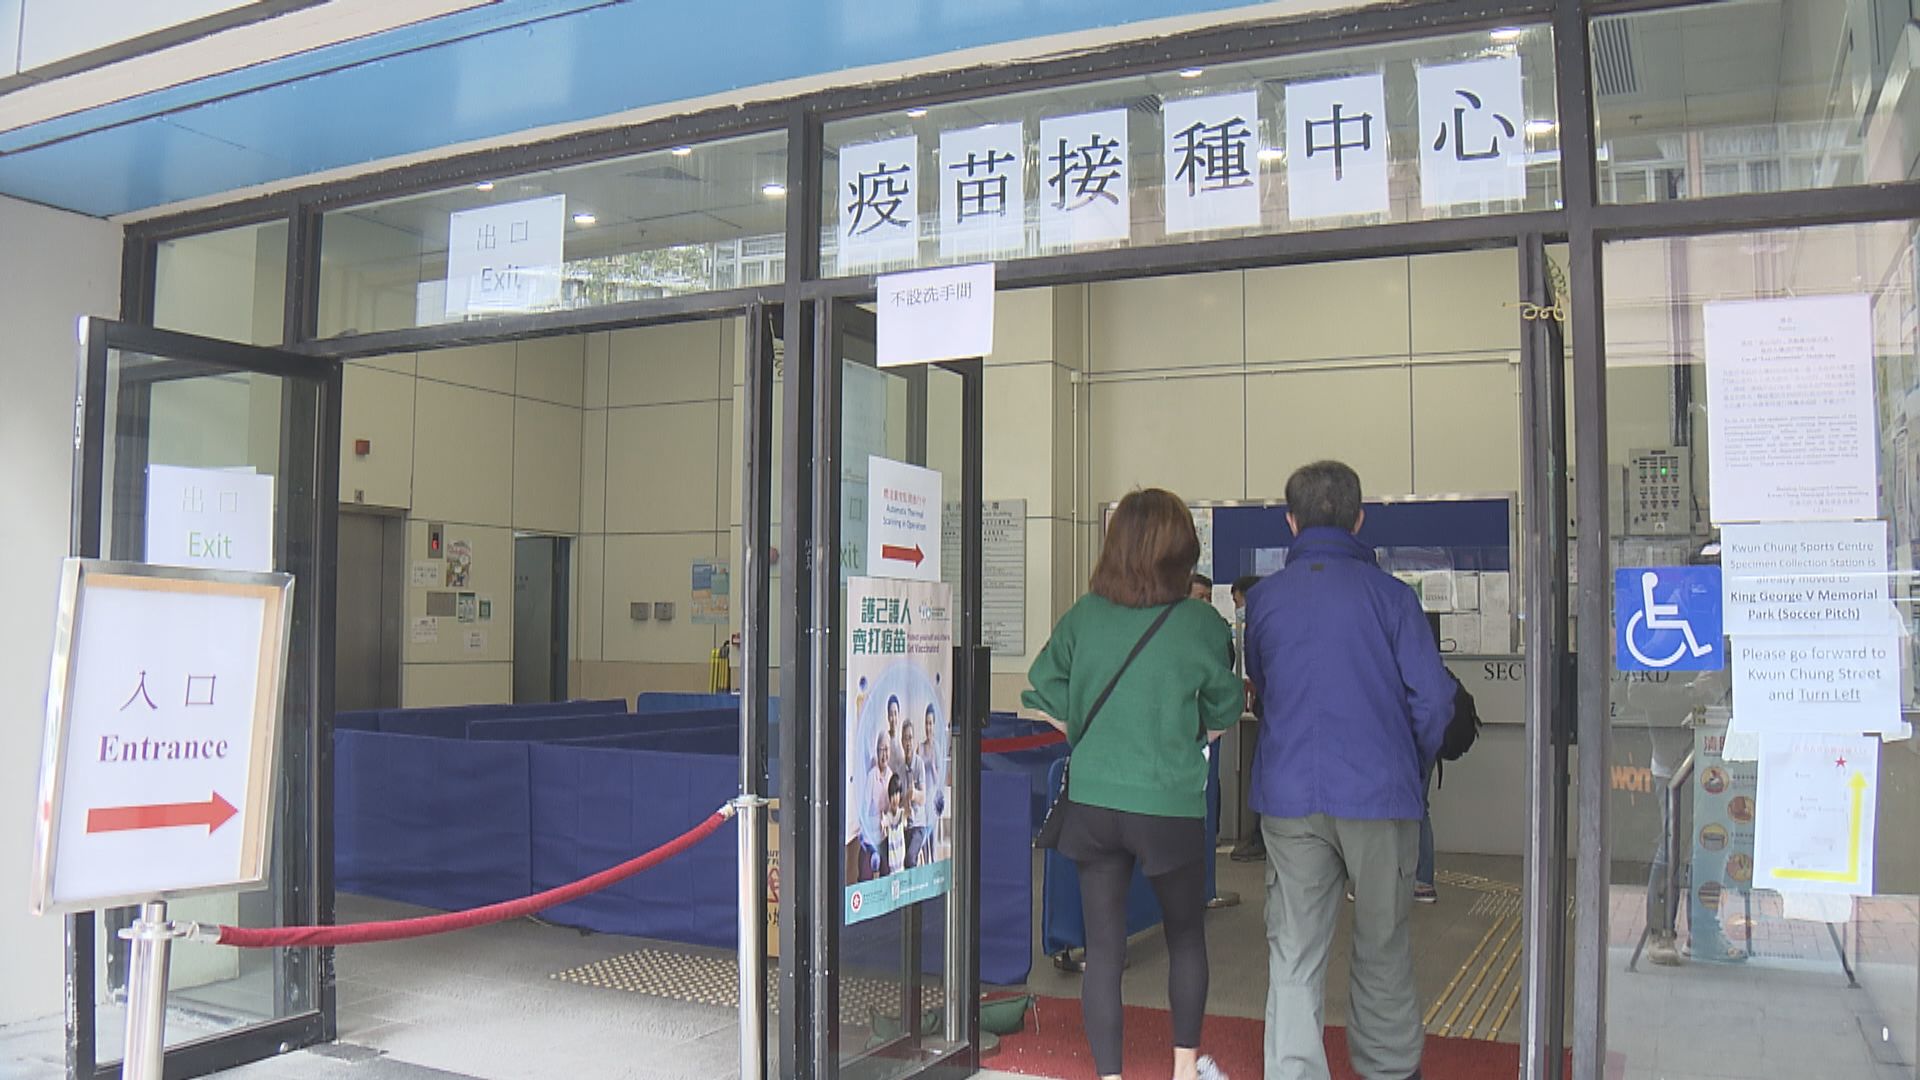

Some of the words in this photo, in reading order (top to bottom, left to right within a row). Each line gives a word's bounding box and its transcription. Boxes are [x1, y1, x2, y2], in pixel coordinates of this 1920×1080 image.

[847, 88, 1516, 237] 疫苗接種中心
[476, 219, 528, 252] 出口
[182, 485, 239, 513] 出口
[189, 530, 233, 560] Exit
[841, 538, 859, 570] xit
[1731, 542, 1761, 554] Kwun
[1763, 541, 1798, 555] Chung
[1800, 541, 1835, 554] Sports
[1837, 541, 1874, 552] Centre
[1730, 559, 1777, 570] Specimen
[1779, 558, 1827, 569] Collection
[1829, 557, 1860, 568] Station
[1862, 557, 1876, 568] is
[1730, 589, 1757, 604] King
[1759, 590, 1803, 605] George
[1806, 589, 1815, 601] V
[1818, 588, 1878, 600] Memorial
[861, 596, 912, 625] 護己護人
[1748, 608, 1775, 621] Park
[1778, 608, 1821, 622] (Soccer
[1825, 607, 1861, 621] Pitch)
[852, 628, 906, 655] 齊打疫苗
[1742, 646, 1786, 661] Please
[1789, 649, 1807, 663] go
[1811, 645, 1867, 660] forward
[1872, 647, 1887, 660] to
[1484, 661, 1527, 682] SEC
[1748, 669, 1786, 681] Kwun
[1789, 667, 1835, 683] Chung
[1838, 667, 1882, 681] Street
[119, 668, 217, 712] 入口
[1768, 688, 1795, 701] and
[1798, 688, 1831, 702] Turn
[1834, 687, 1862, 701] Left
[98, 733, 229, 763] Entrance
